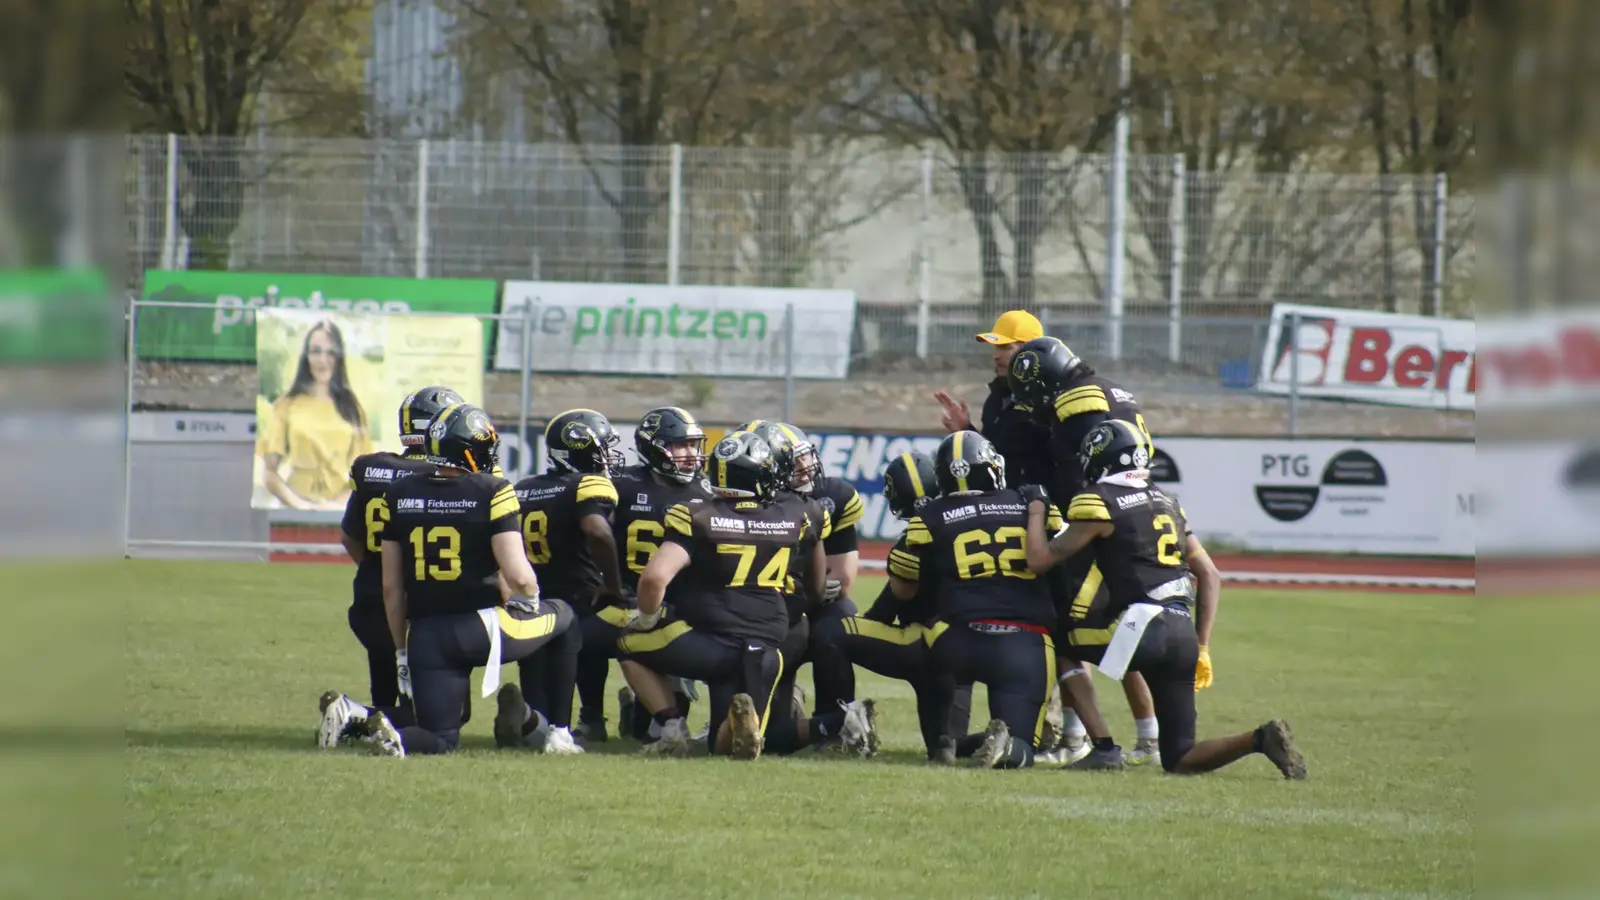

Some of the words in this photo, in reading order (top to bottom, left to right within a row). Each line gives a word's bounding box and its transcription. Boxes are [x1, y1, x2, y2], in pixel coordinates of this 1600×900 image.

[572, 297, 767, 345] printzen
[1343, 327, 1475, 392] Ber
[365, 467, 385, 478] LVM
[1261, 455, 1310, 477] PTG
[397, 498, 414, 509] LVM
[427, 499, 478, 508] Fickenscher
[530, 486, 566, 496] Fickenscher
[710, 516, 734, 529] LVM
[747, 520, 795, 529] Fickenscher
[943, 507, 965, 521] LVM
[410, 526, 463, 581] 13
[953, 527, 1036, 579] 62
[1153, 514, 1181, 565] 2
[717, 543, 791, 588] 74
